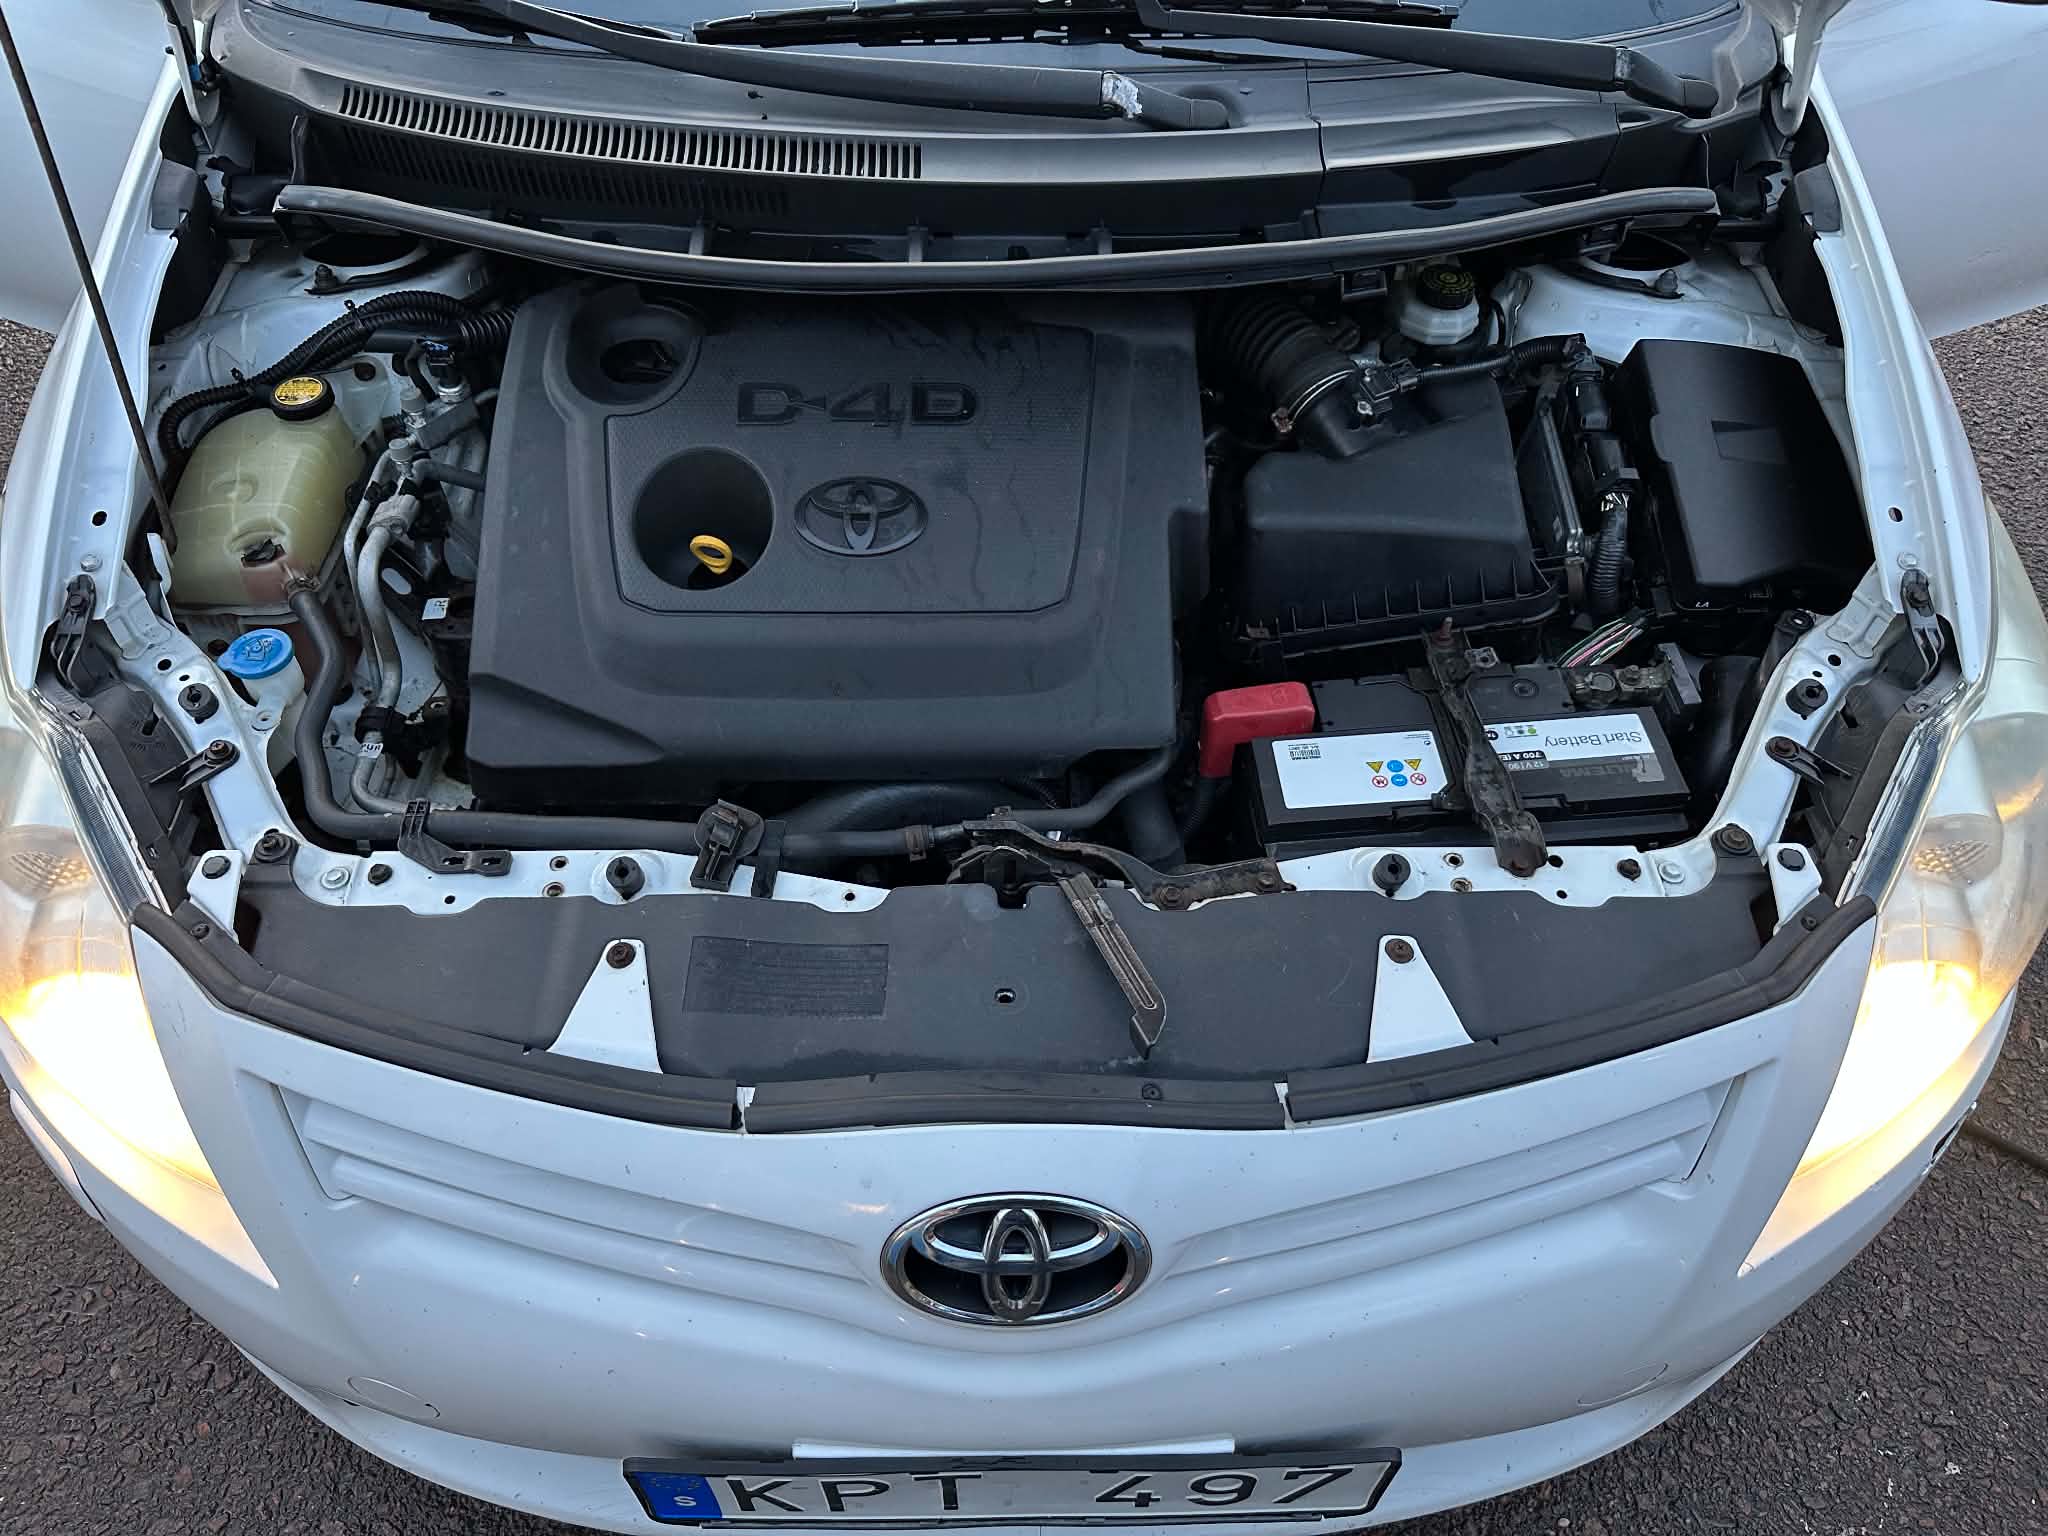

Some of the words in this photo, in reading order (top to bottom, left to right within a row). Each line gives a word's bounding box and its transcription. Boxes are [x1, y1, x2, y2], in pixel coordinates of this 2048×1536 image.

[736, 381, 977, 427] D-4D
[1544, 734, 1601, 748] Battery
[1601, 731, 1642, 744] Start
[1522, 751, 1544, 760] 700
[726, 1473, 982, 1512] KPT
[1095, 1467, 1354, 1508] 497
[673, 1495, 697, 1507] S
